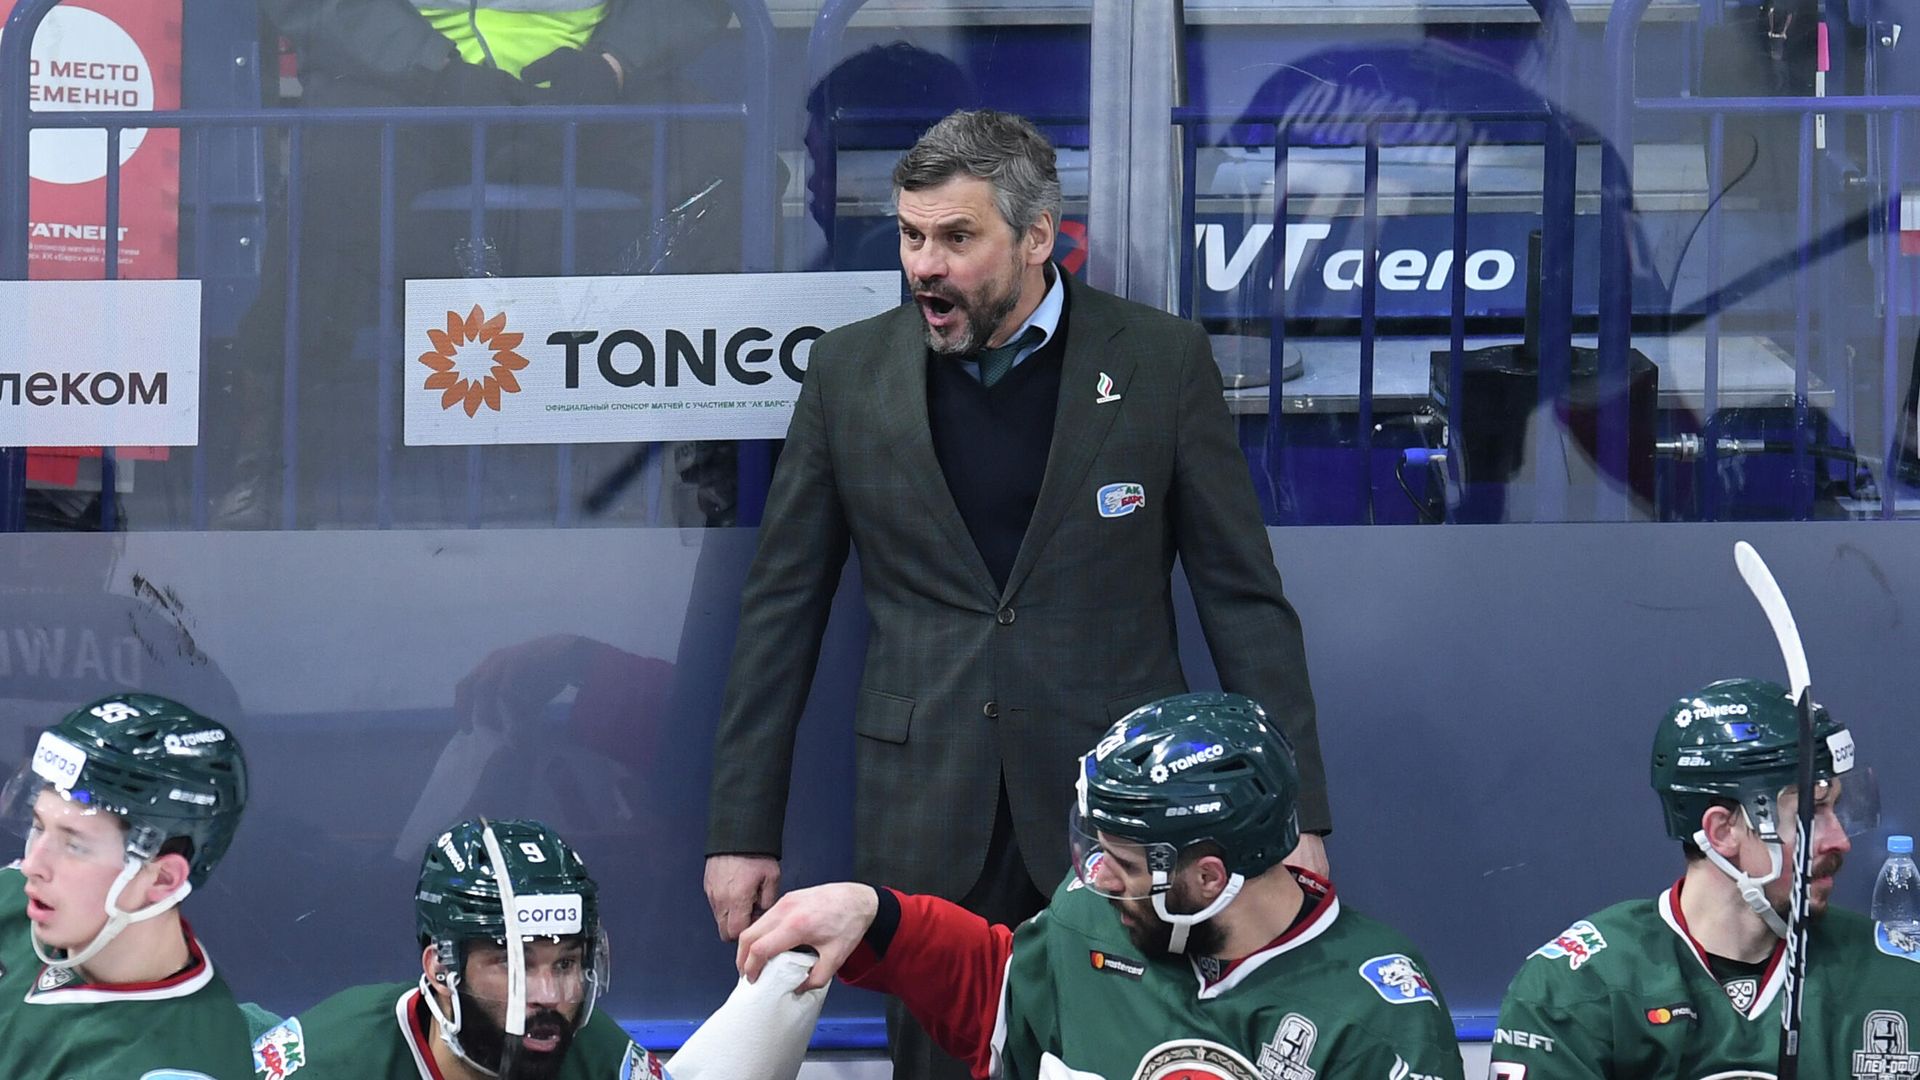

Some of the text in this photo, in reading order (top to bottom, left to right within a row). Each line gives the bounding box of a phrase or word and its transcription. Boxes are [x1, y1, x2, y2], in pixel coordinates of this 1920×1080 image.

[50, 60, 139, 82] МЕСТО
[30, 85, 139, 107] ЕМЕННО
[29, 222, 129, 241] ATNET
[1322, 249, 1516, 292] aero
[545, 403, 609, 412] ОФИЦИАЛЬНЫЙ
[610, 402, 650, 411] СПОНСОР
[651, 400, 684, 410] МАТЧЕЙ
[685, 401, 691, 409] С
[692, 401, 735, 410] УЧАСТИЕМ
[1167, 743, 1225, 774] TANECO
[518, 842, 547, 863] 9
[517, 907, 578, 923] согаз
[1493, 1028, 1556, 1053] NEFT
